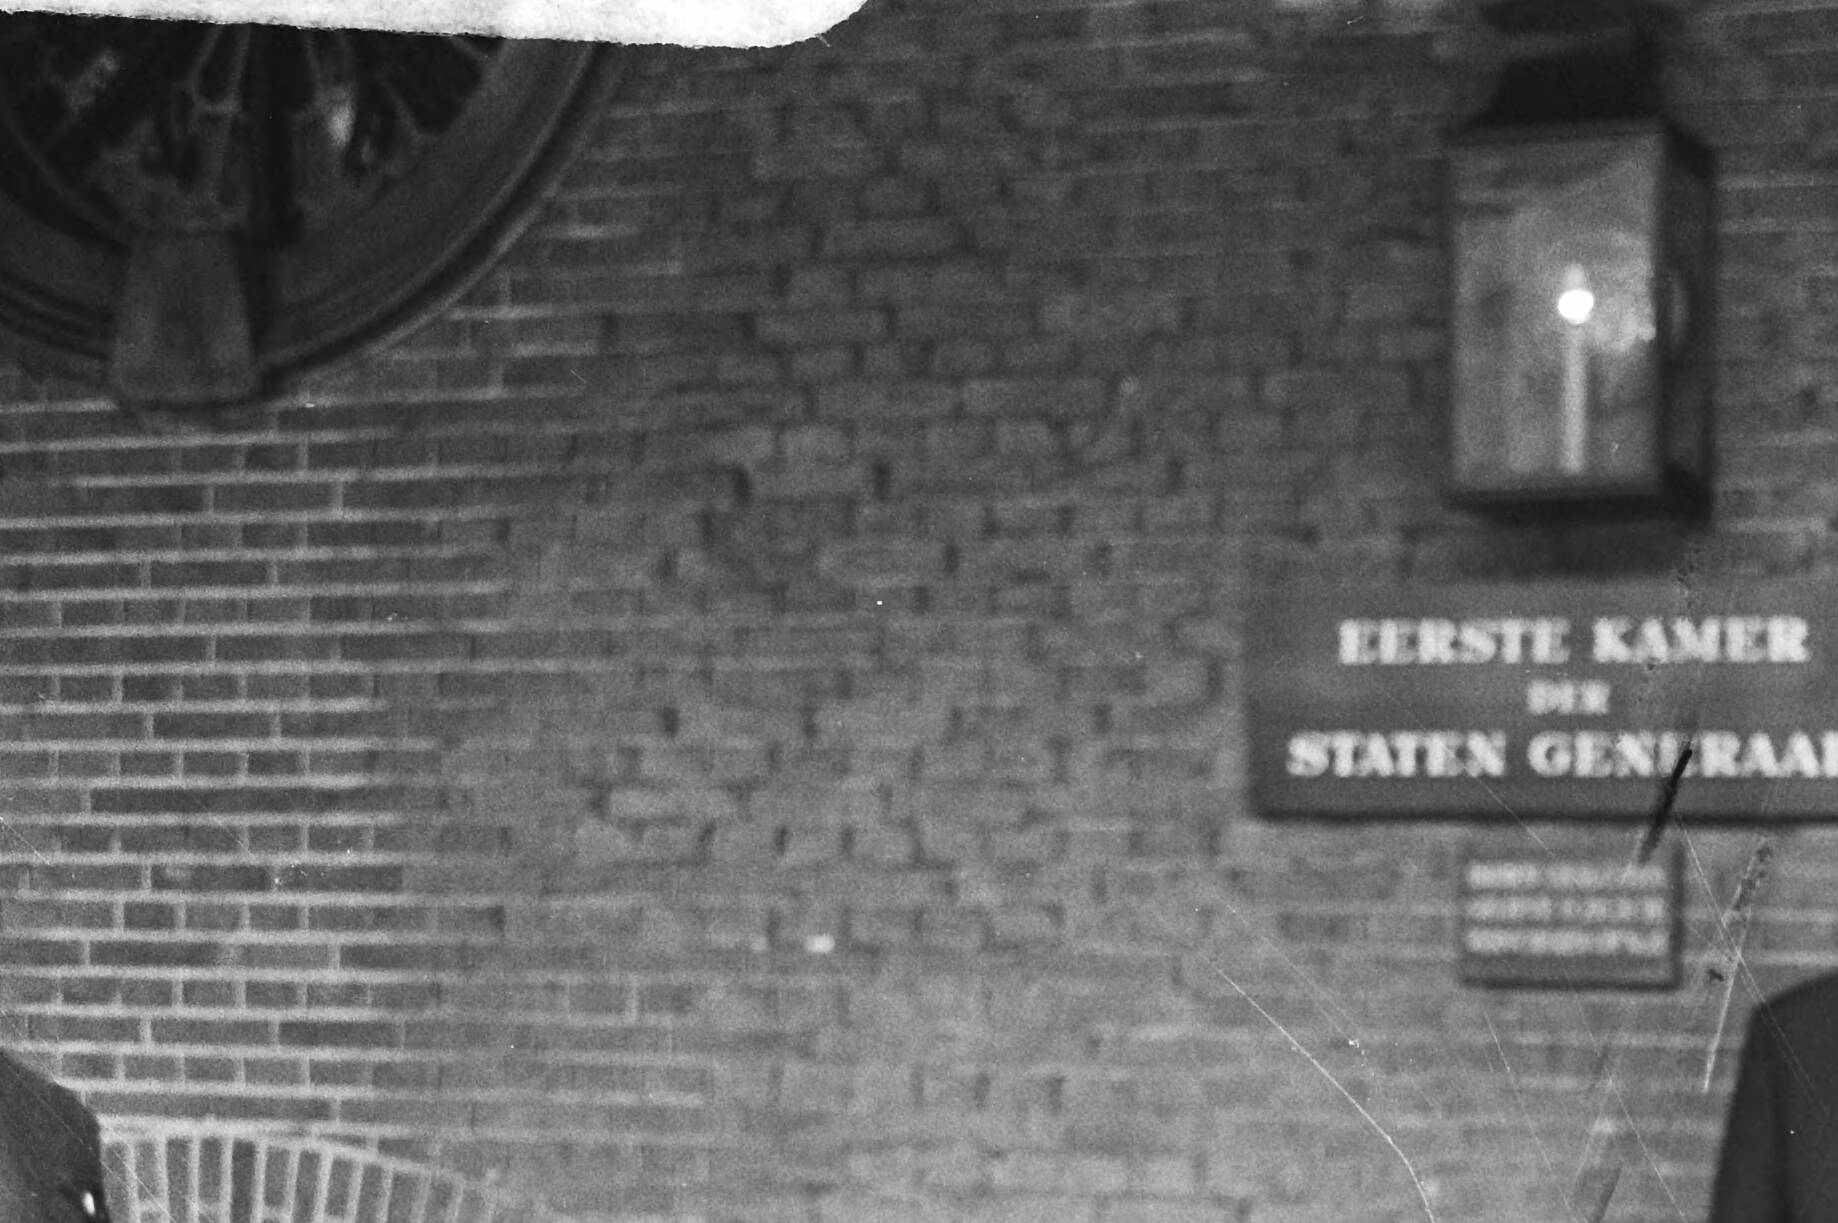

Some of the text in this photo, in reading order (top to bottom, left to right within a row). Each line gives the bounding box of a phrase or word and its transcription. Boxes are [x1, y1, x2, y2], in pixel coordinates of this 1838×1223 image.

[1338, 615, 1812, 664] EERSTE KAMER
[1287, 730, 1507, 778] STATEN
